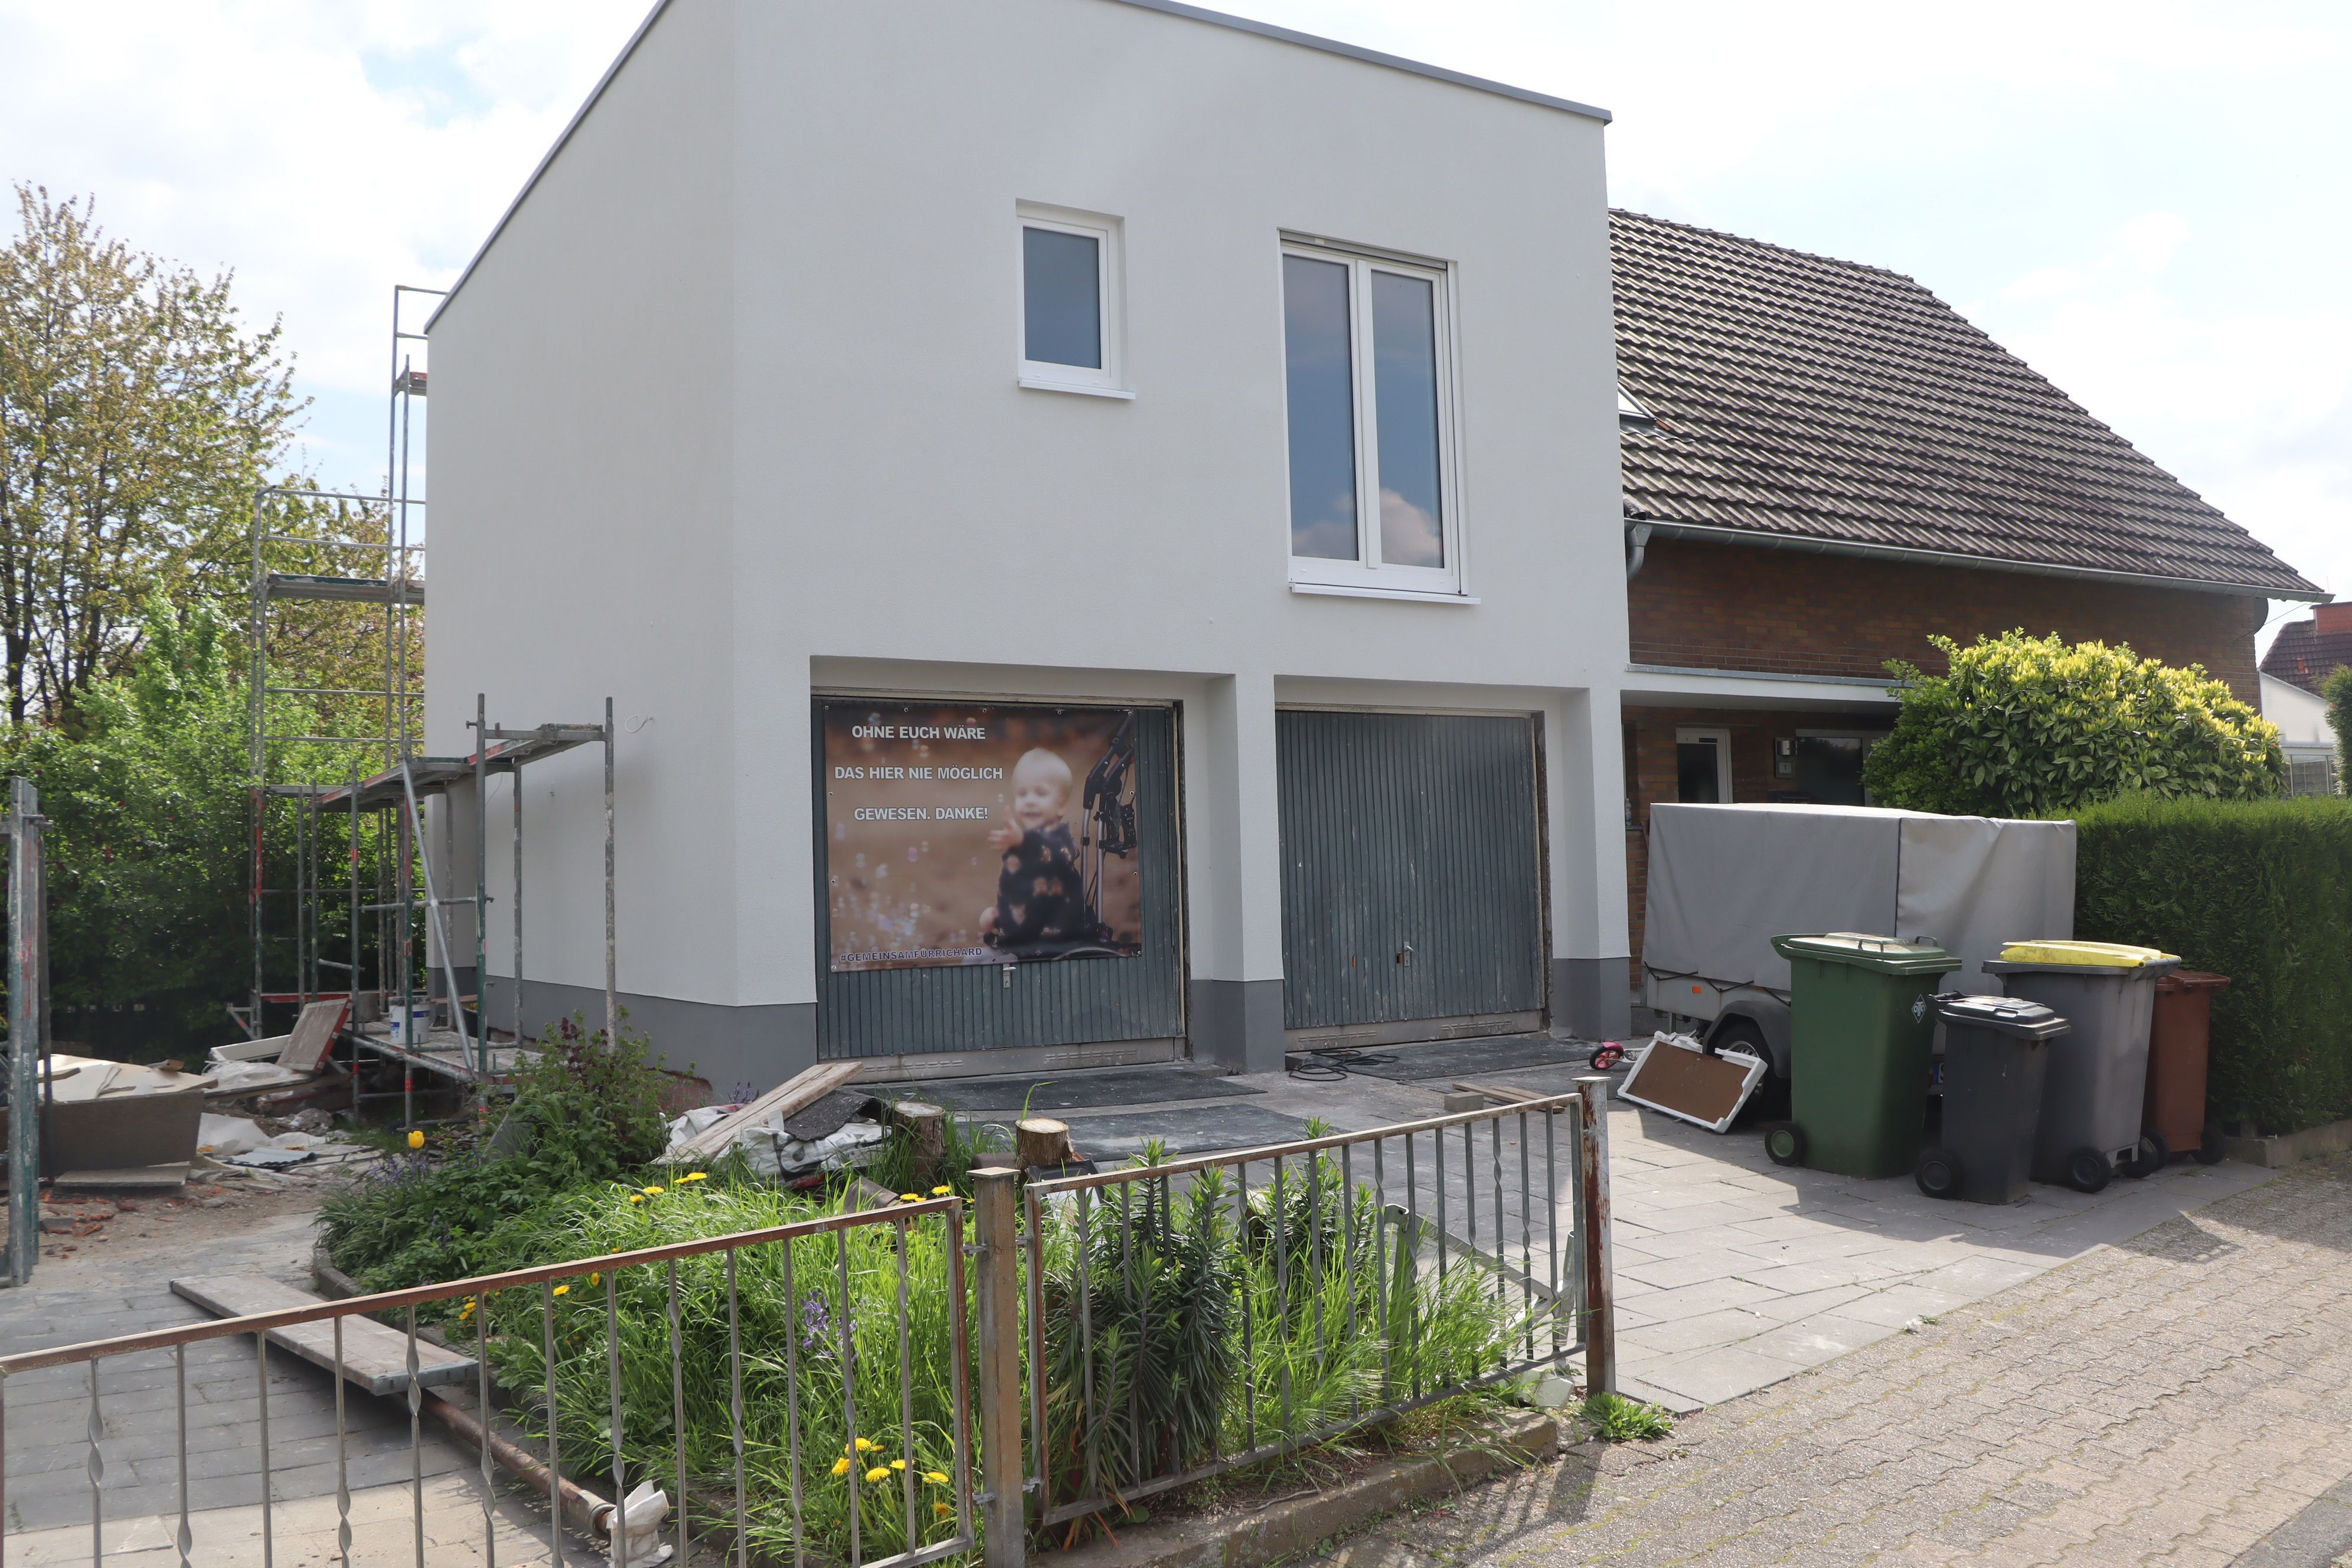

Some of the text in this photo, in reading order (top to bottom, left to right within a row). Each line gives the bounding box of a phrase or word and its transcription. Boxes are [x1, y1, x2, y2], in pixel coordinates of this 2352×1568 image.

[852, 724, 986, 740] OHNE EUCH WÄRE
[834, 765, 1003, 779] DAS HIER NIE MÖGLICH
[854, 807, 988, 821] GEWESEN. DANKE!
[840, 948, 982, 963] #GEMEINSAMFÜRRICHARD
